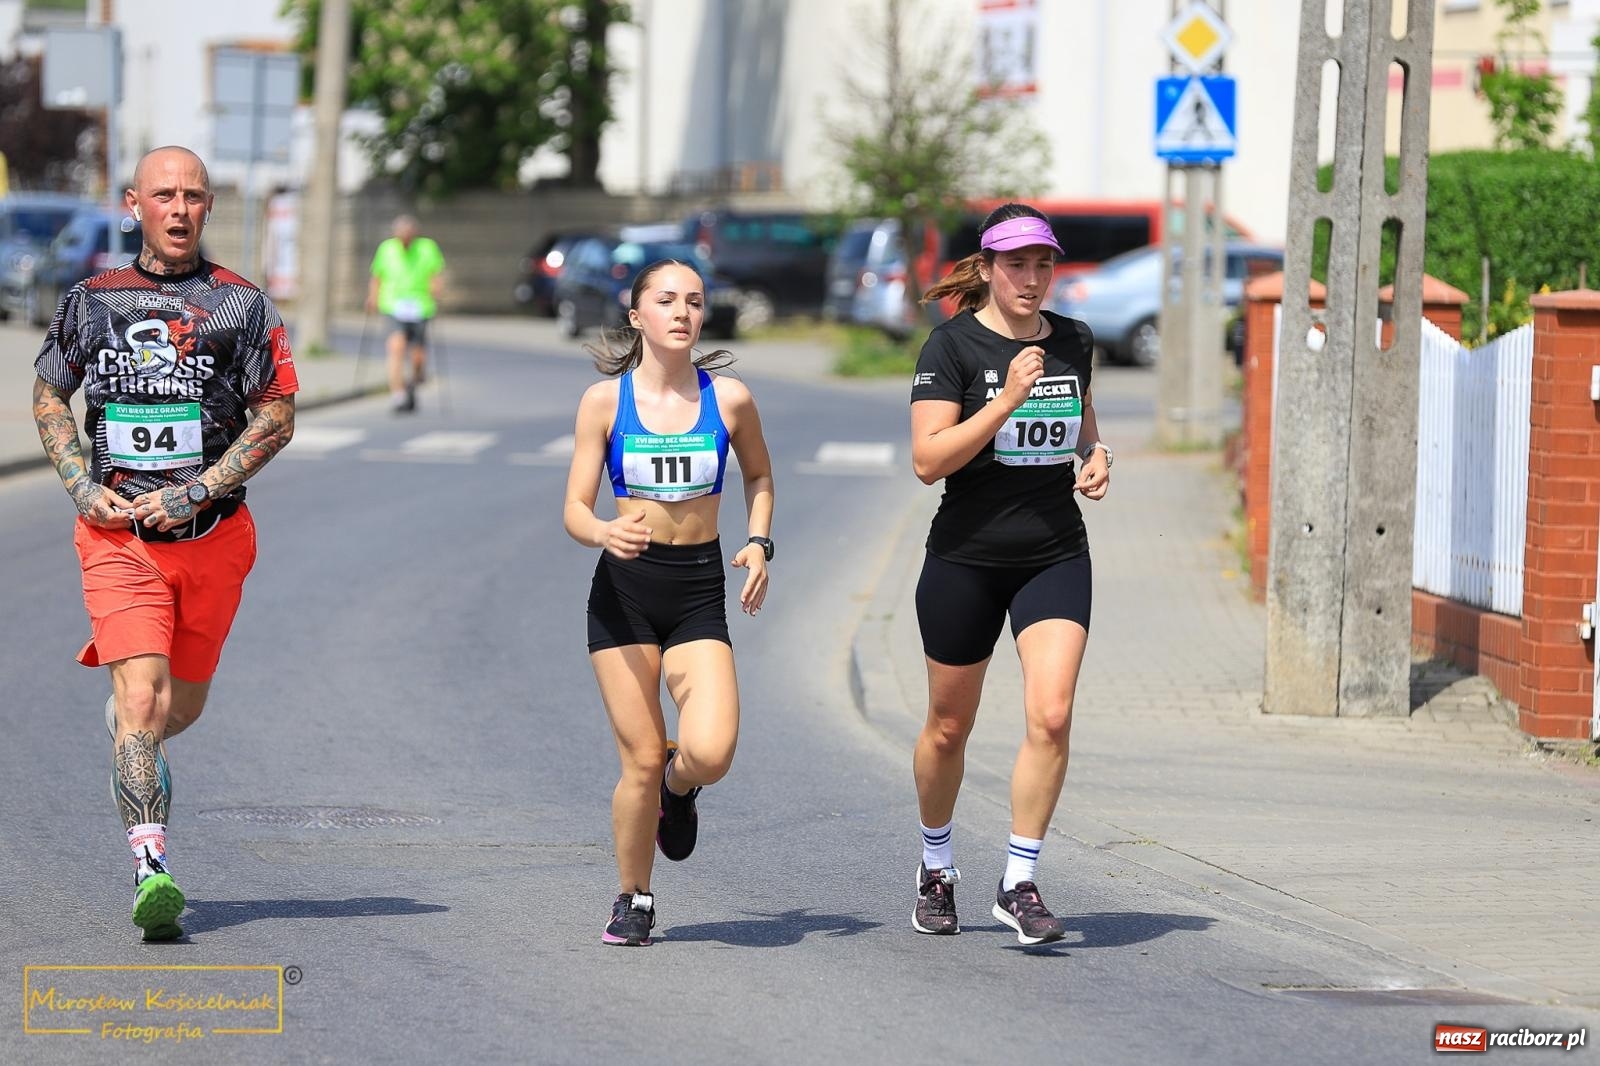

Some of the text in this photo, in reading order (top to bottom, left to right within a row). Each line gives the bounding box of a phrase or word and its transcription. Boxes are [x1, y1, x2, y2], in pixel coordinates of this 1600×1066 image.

[116, 406, 128, 414] XVI
[160, 406, 189, 414] GRANIC
[1051, 401, 1074, 409] GRANIC
[131, 426, 177, 453] 94
[1015, 421, 1066, 447] 109
[651, 456, 691, 483] 111
